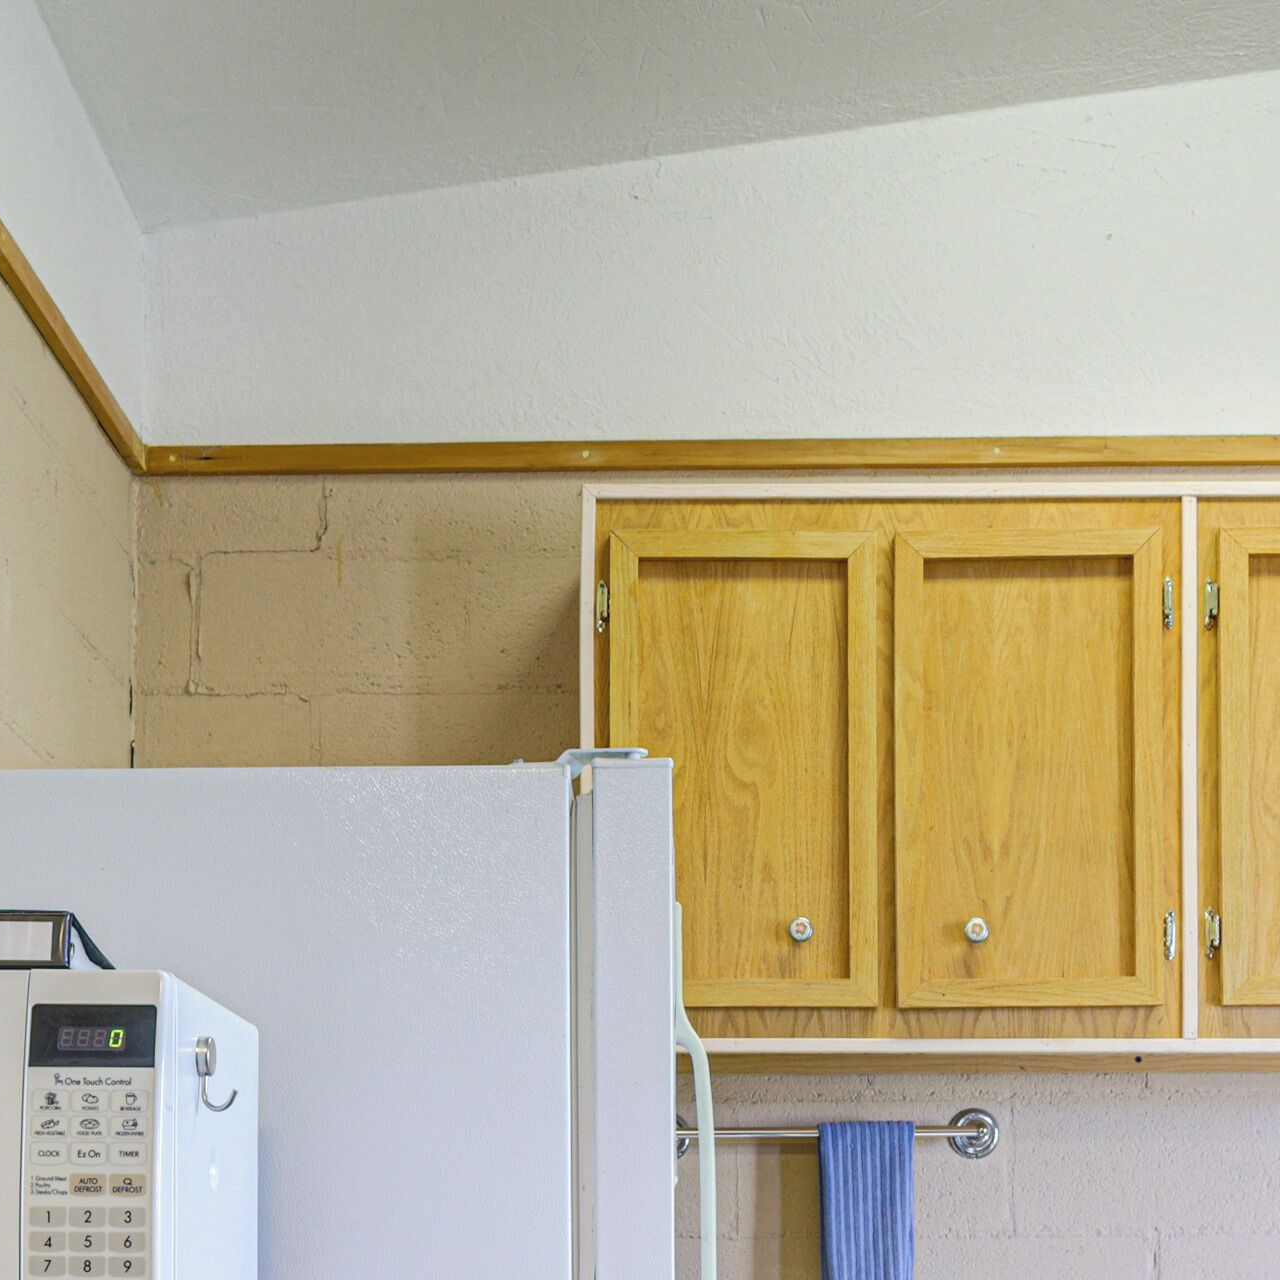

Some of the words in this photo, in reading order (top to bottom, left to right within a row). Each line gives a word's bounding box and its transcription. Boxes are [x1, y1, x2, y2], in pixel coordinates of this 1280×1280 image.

[83, 1077, 103, 1085] Touch
[105, 1077, 132, 1086] Control
[47, 1211, 51, 1223] 1
[84, 1210, 92, 1223] 2
[124, 1211, 132, 1223] 3
[44, 1236, 52, 1248] 4
[84, 1236, 92, 1248] 5
[124, 1236, 132, 1248] 6
[44, 1260, 51, 1272] 7
[83, 1260, 92, 1272] 8
[124, 1261, 132, 1272] 9
